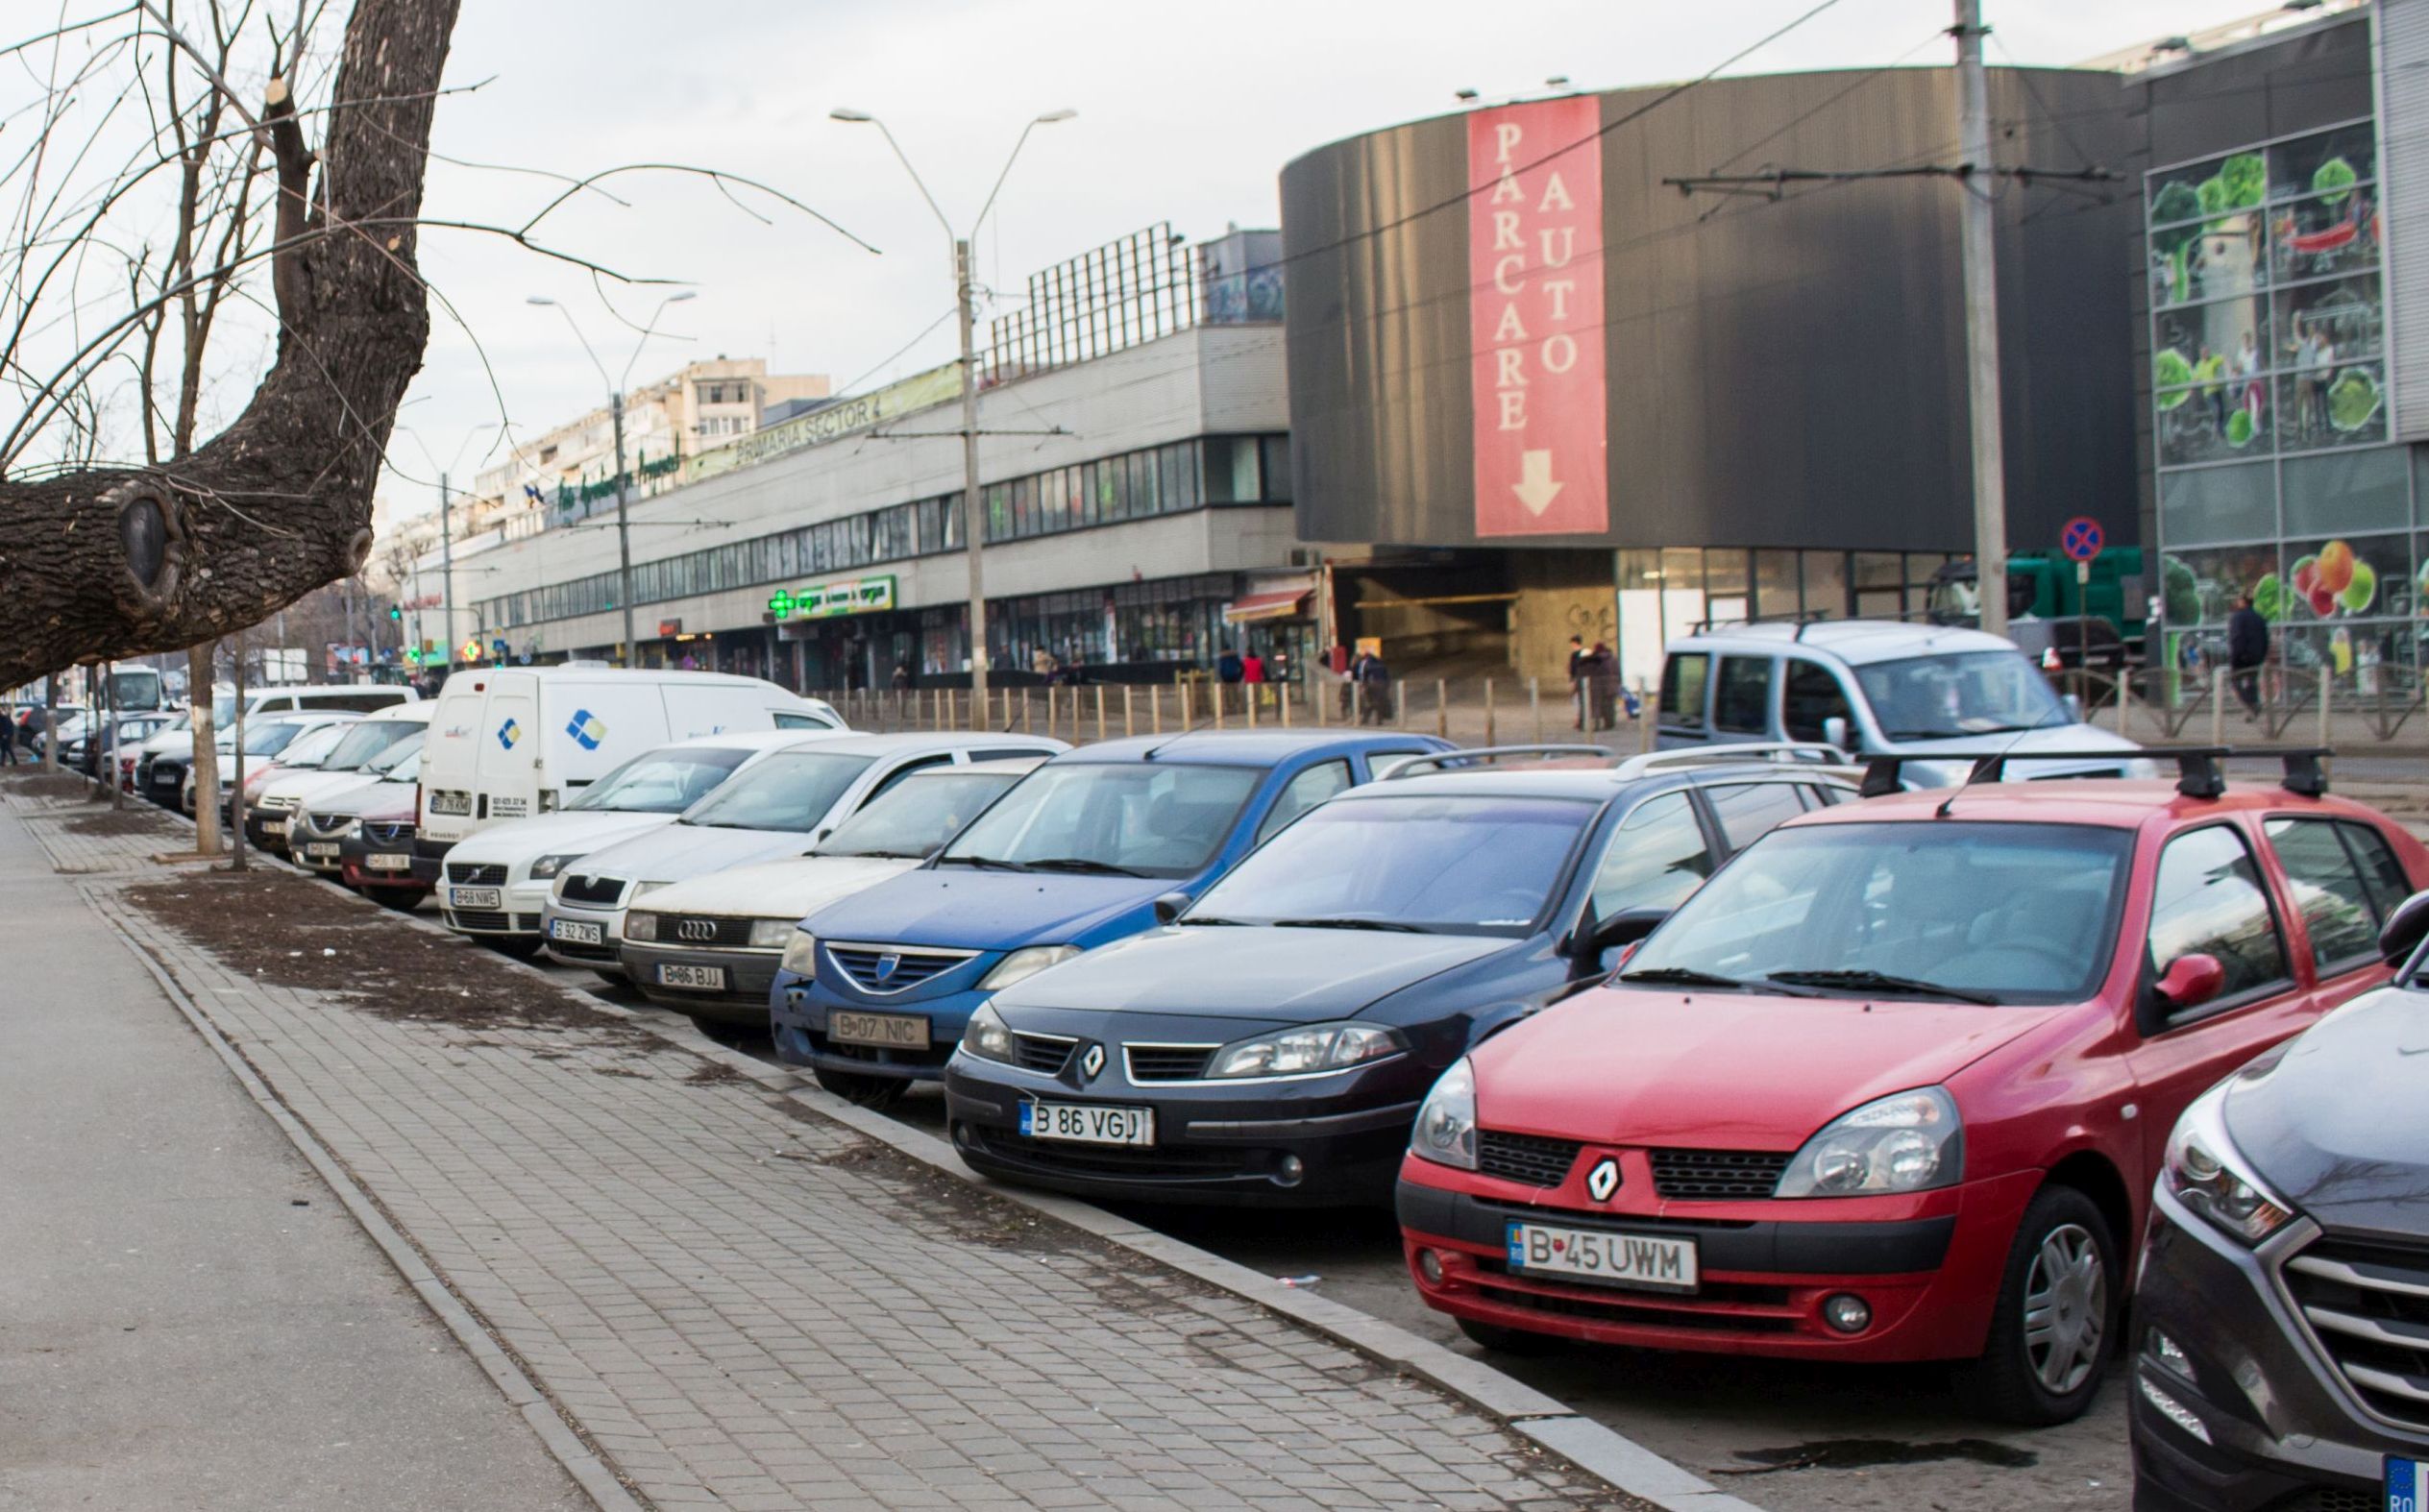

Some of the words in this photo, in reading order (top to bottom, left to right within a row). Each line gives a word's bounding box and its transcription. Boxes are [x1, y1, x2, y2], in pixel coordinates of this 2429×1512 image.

[1490, 122, 1530, 431] PARCARE
[1537, 170, 1578, 374] AUTO
[805, 401, 870, 438] SECTOR
[456, 890, 463, 903] B
[555, 922, 563, 938] B
[565, 923, 577, 939] 92
[665, 965, 674, 983] B
[695, 967, 719, 987] BJJ
[840, 1014, 851, 1036] B
[858, 1016, 877, 1039] 07
[885, 1019, 915, 1042] NIC
[1037, 1107, 1050, 1132] B
[1058, 1109, 1084, 1134] 86
[1091, 1110, 1138, 1139] VGJ
[1530, 1229, 1551, 1264] B
[1564, 1233, 1600, 1270] 45
[1607, 1237, 1681, 1280] UWM
[2390, 1495, 2414, 1512] RO
